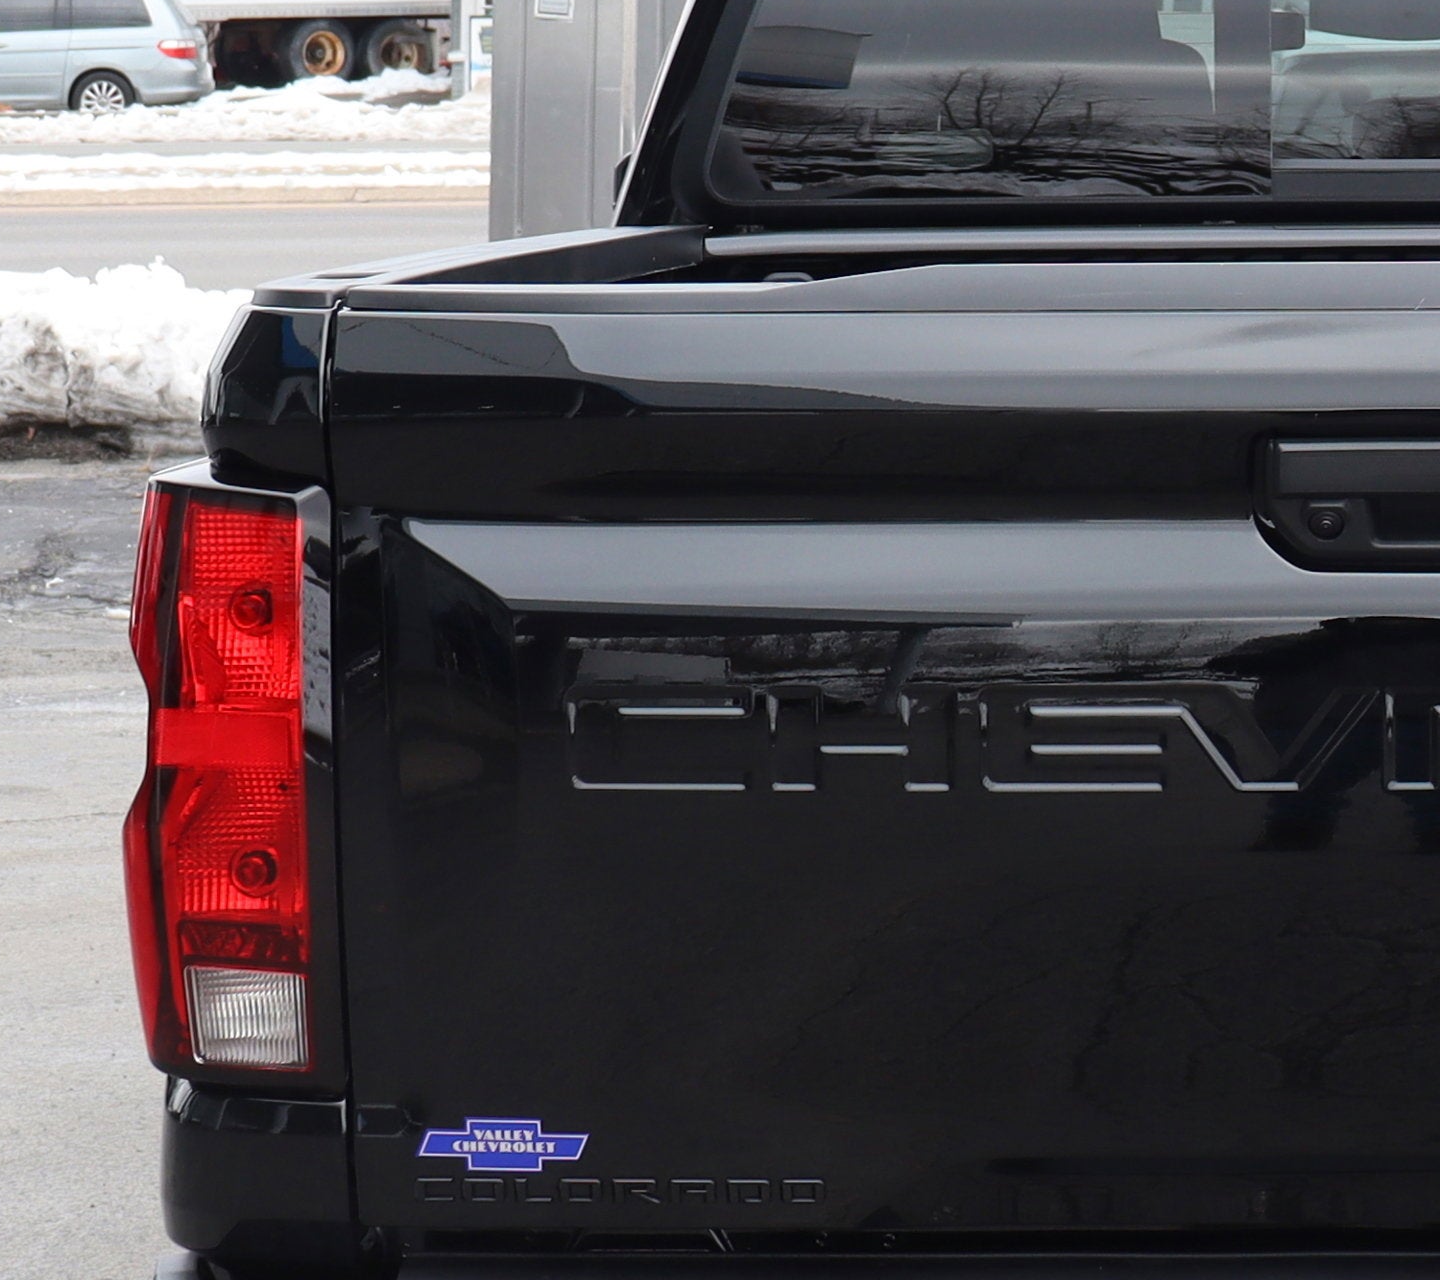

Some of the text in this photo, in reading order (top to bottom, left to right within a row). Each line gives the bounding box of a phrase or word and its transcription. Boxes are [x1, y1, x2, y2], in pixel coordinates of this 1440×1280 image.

[473, 1129, 535, 1142] VALLEY
[452, 1140, 557, 1154] CHEVROLET
[415, 1176, 825, 1204] COLORADO
